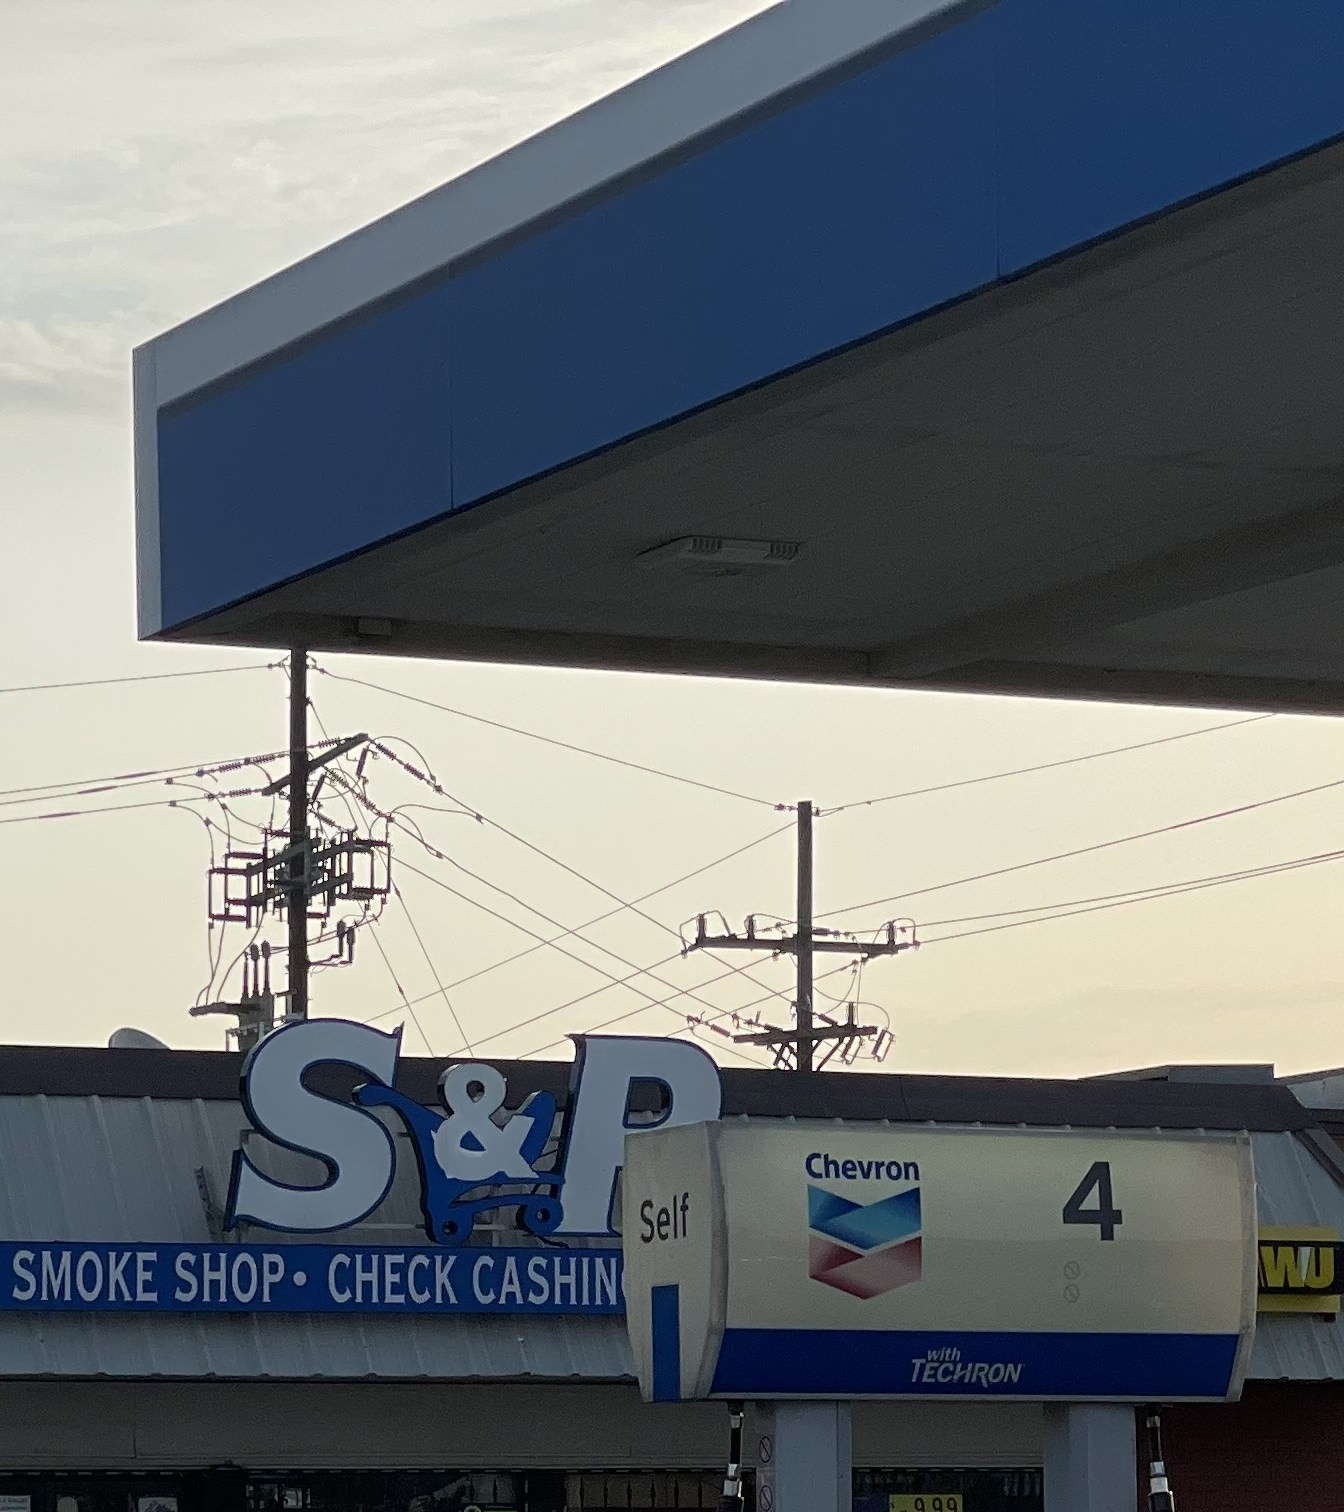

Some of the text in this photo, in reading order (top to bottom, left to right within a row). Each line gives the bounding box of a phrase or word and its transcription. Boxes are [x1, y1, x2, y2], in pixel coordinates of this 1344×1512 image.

[805, 1152, 920, 1182] Chevron
[641, 1192, 689, 1243] Self
[1063, 1161, 1122, 1240] 4
[11, 1250, 158, 1303] SMOKE
[327, 1253, 457, 1305] CHECK
[472, 1255, 626, 1306] CASHIN
[1260, 1246, 1335, 1289] WU
[911, 1359, 1023, 1388] TECHRON
[928, 1346, 960, 1362] with
